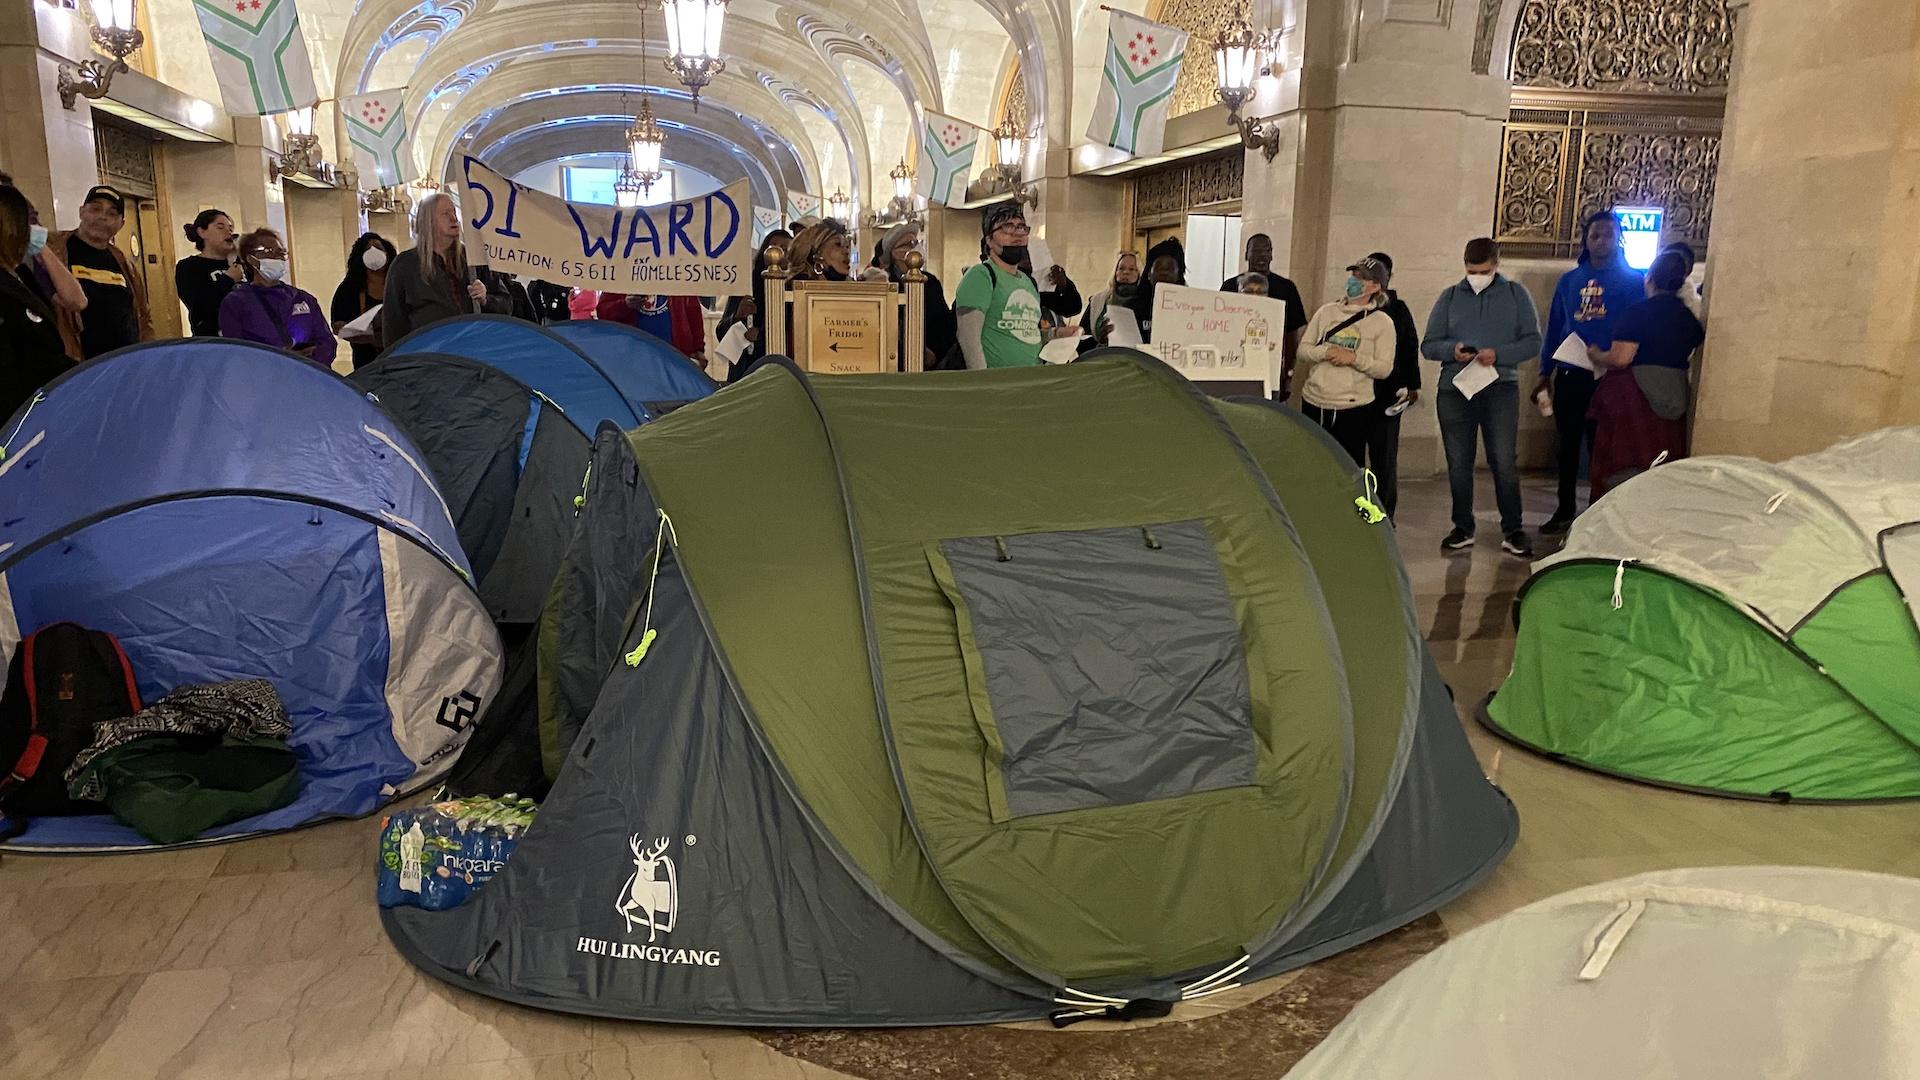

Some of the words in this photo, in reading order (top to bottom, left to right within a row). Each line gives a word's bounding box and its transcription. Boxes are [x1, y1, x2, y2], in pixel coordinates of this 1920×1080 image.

[567, 190, 741, 260] WARD
[1620, 214, 1655, 231] ATM
[631, 264, 737, 285] HOMELESSNESS
[824, 316, 869, 328] FARMER'S
[1202, 319, 1231, 333] HOME
[829, 328, 865, 339] FRIDGE
[830, 363, 861, 372] SNACK
[443, 853, 505, 873] niagara
[576, 937, 608, 955] HUI
[610, 942, 721, 967] LINGYANG
